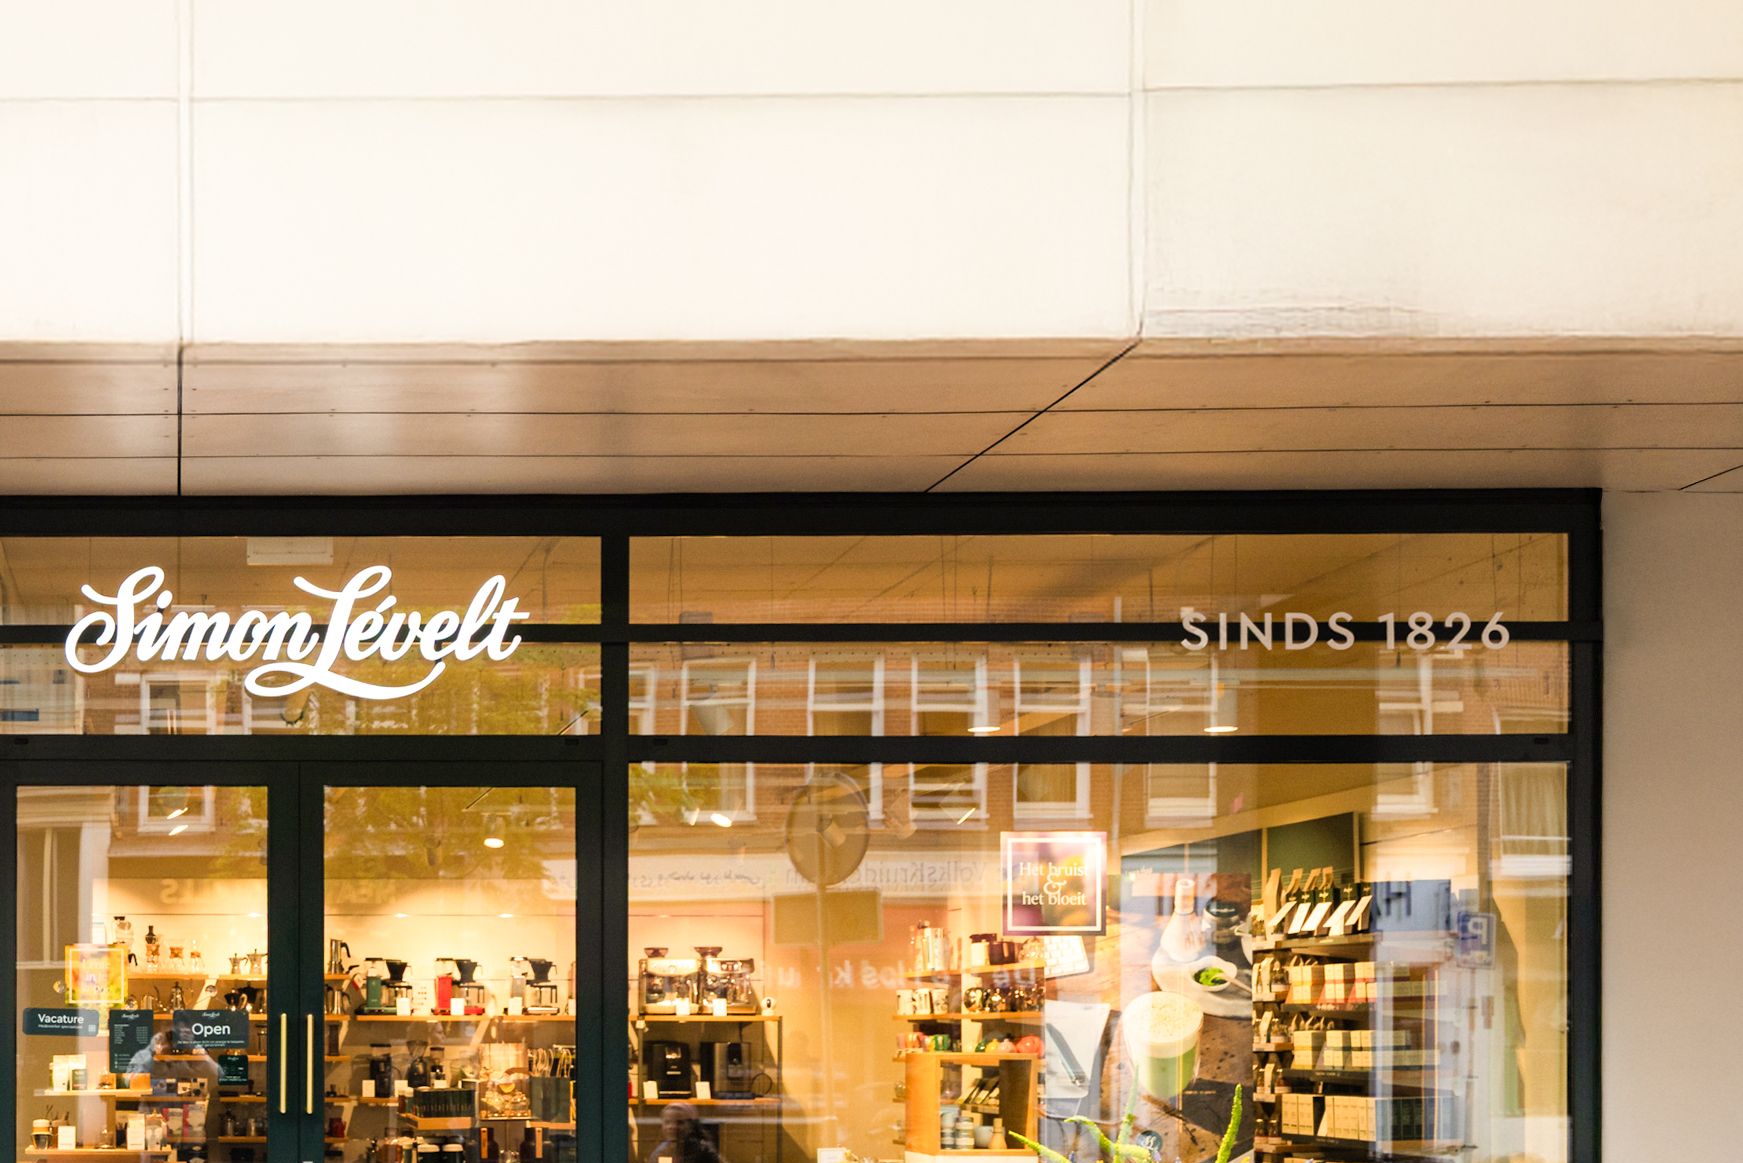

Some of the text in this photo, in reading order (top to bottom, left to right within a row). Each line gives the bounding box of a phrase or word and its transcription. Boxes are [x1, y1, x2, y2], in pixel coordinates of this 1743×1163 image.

[65, 565, 531, 699] Simon Lévelt
[1180, 611, 1510, 651] SINDS 1826
[1019, 862, 1088, 877] Het bruist
[1043, 875, 1067, 895] &
[1022, 891, 1088, 906] het bloeit
[37, 1013, 85, 1024] Vacature
[191, 1022, 231, 1037] Open
